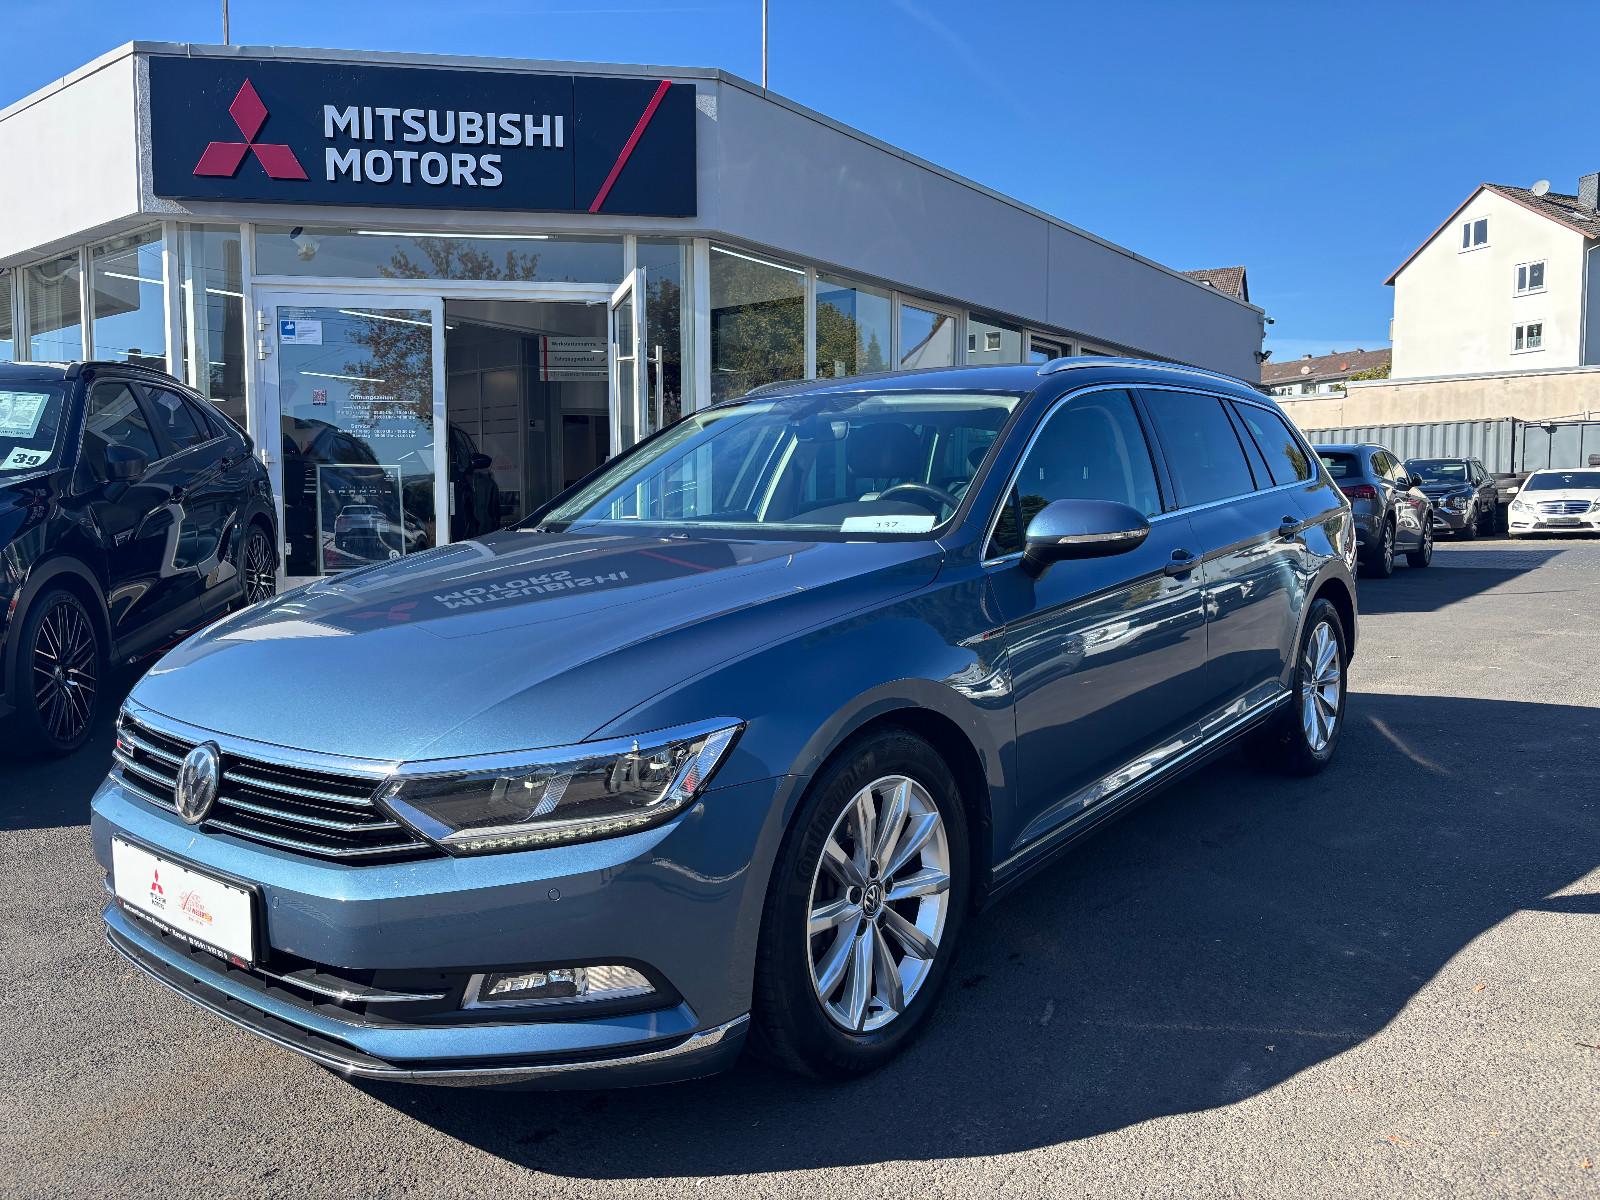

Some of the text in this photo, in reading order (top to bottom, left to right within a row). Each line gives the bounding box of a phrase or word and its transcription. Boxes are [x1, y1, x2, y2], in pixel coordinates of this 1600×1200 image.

[323, 105, 564, 148] MITSUBISHI
[325, 148, 502, 187] MOTORS
[12, 453, 41, 466] 39
